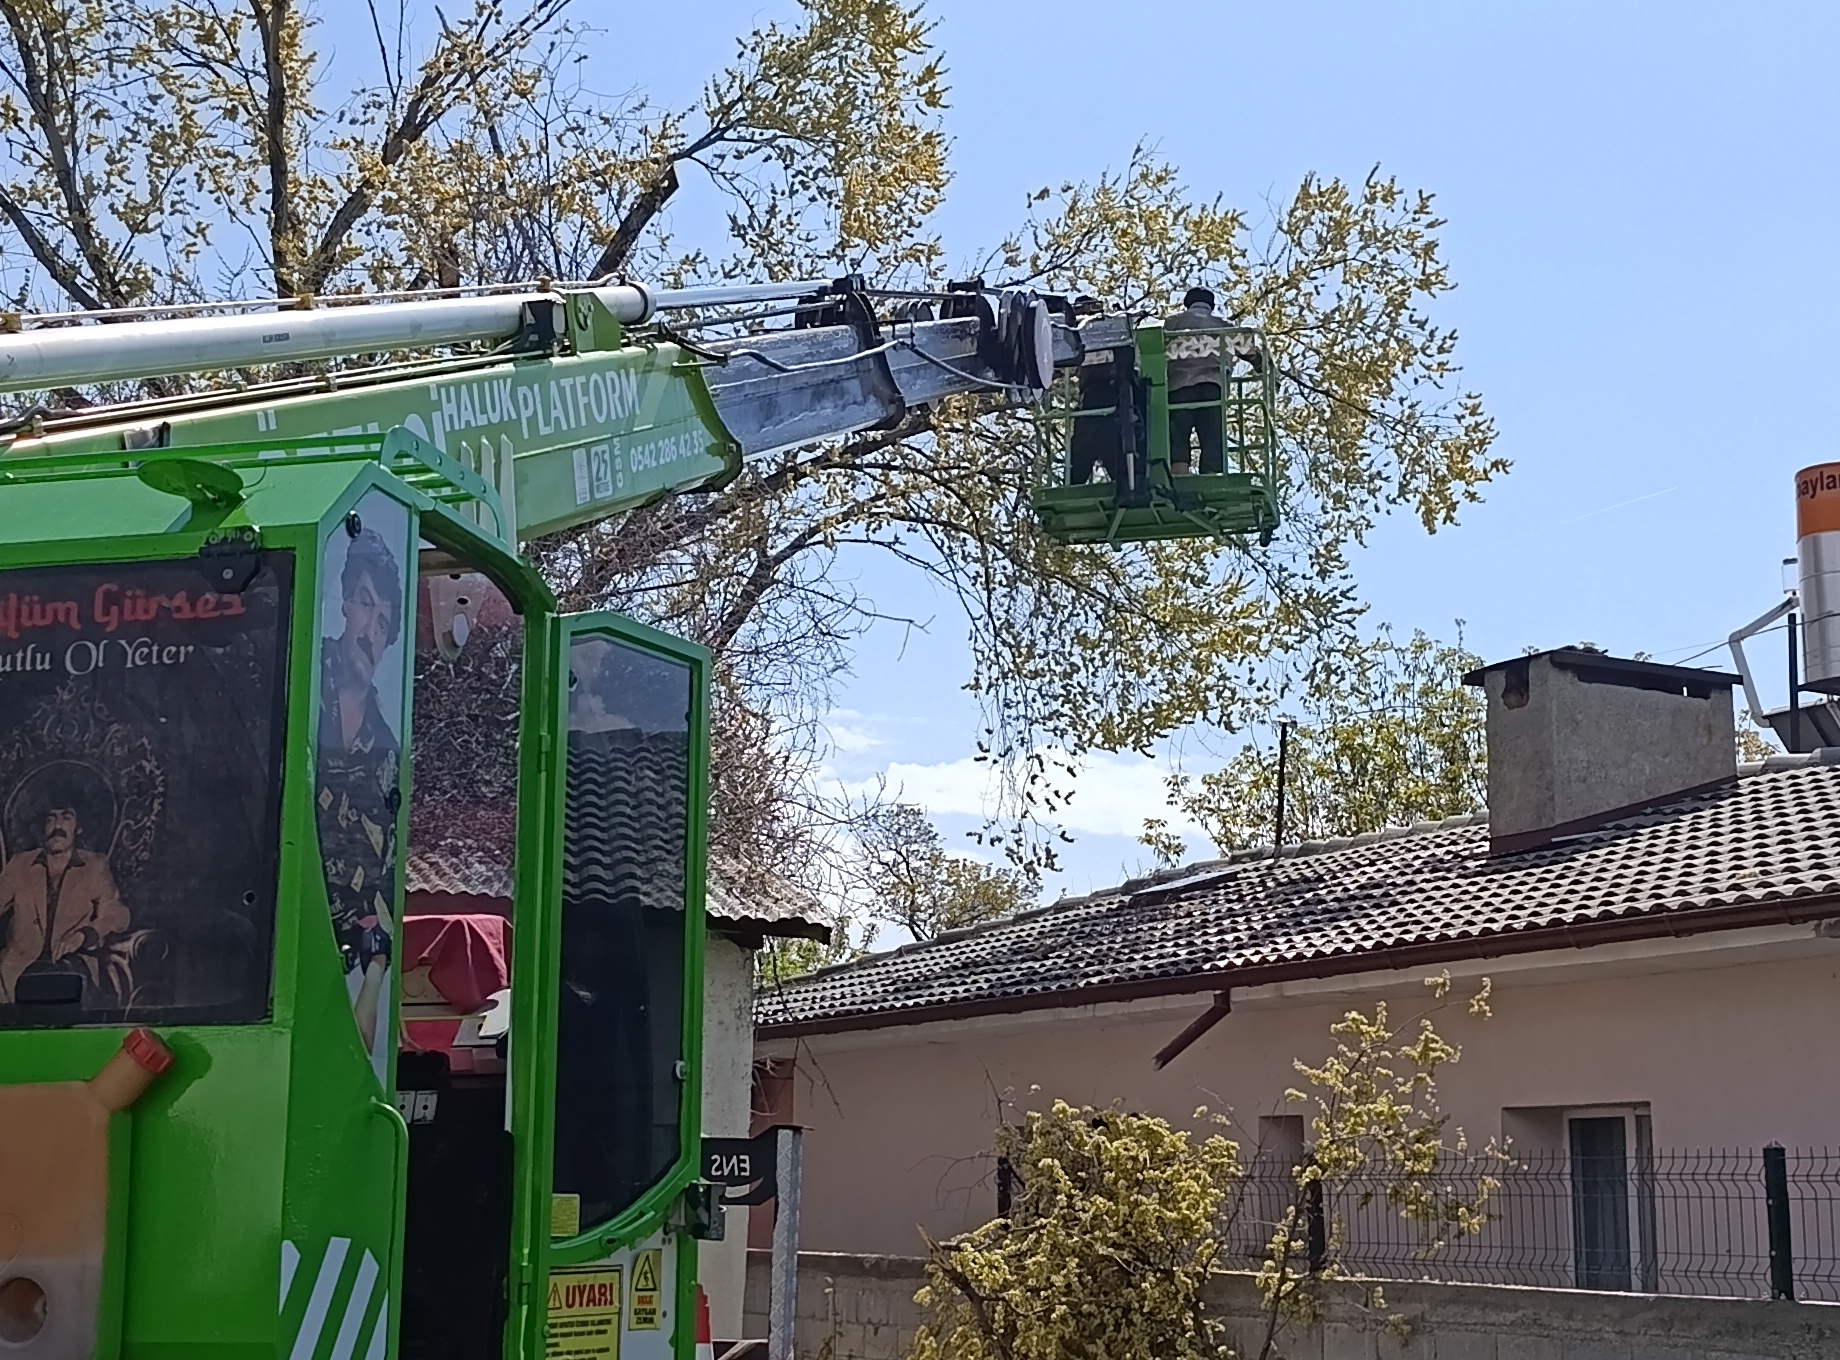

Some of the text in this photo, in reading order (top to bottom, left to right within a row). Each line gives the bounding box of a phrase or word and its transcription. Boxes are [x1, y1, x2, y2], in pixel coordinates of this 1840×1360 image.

[440, 378, 517, 432] HALUK
[517, 368, 640, 439] PLATFORM
[630, 429, 705, 474] 0542 286 42 35
[65, 640, 108, 675] Ol
[117, 637, 195, 669] Yeter
